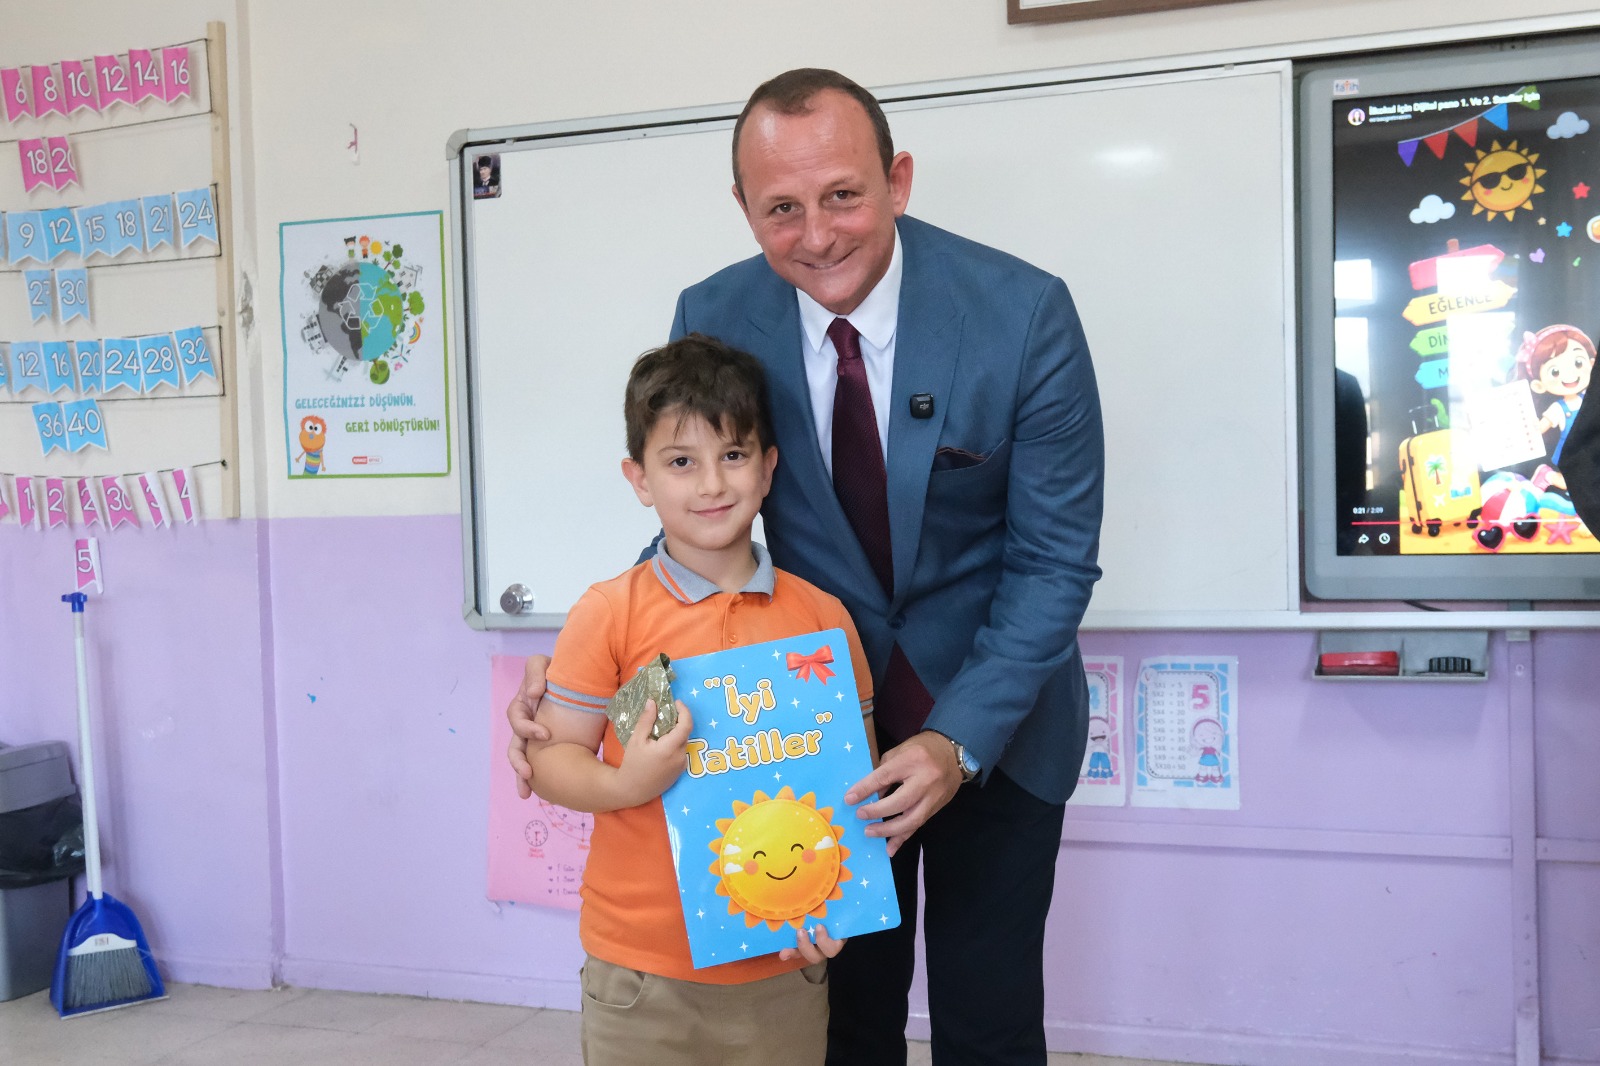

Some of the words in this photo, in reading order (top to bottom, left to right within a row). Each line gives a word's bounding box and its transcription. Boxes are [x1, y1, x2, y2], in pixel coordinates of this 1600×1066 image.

[15, 79, 27, 104] 6
[43, 76, 58, 102] 8
[67, 71, 92, 97] 10
[101, 66, 129, 93] 12
[134, 60, 160, 87] 14
[170, 59, 190, 85] 16
[26, 149, 48, 175] 18
[18, 222, 36, 249] 9
[48, 217, 75, 244] 12
[85, 216, 106, 243] 15
[116, 211, 137, 238] 18
[150, 205, 170, 233] 21
[180, 199, 214, 228] 24
[60, 279, 87, 305] 30
[17, 351, 41, 378] 12
[51, 352, 70, 377] 16
[79, 351, 102, 377] 20
[105, 349, 141, 375] 24
[143, 346, 175, 374] 28
[180, 336, 209, 365] 32
[295, 395, 365, 409] GELECEĞİNİZİ
[38, 412, 63, 438] 36
[67, 408, 102, 436] 40
[345, 419, 370, 433] GERİ
[373, 418, 440, 436] DÖNÜŞTÜRÜN!
[1192, 684, 1210, 709] 5
